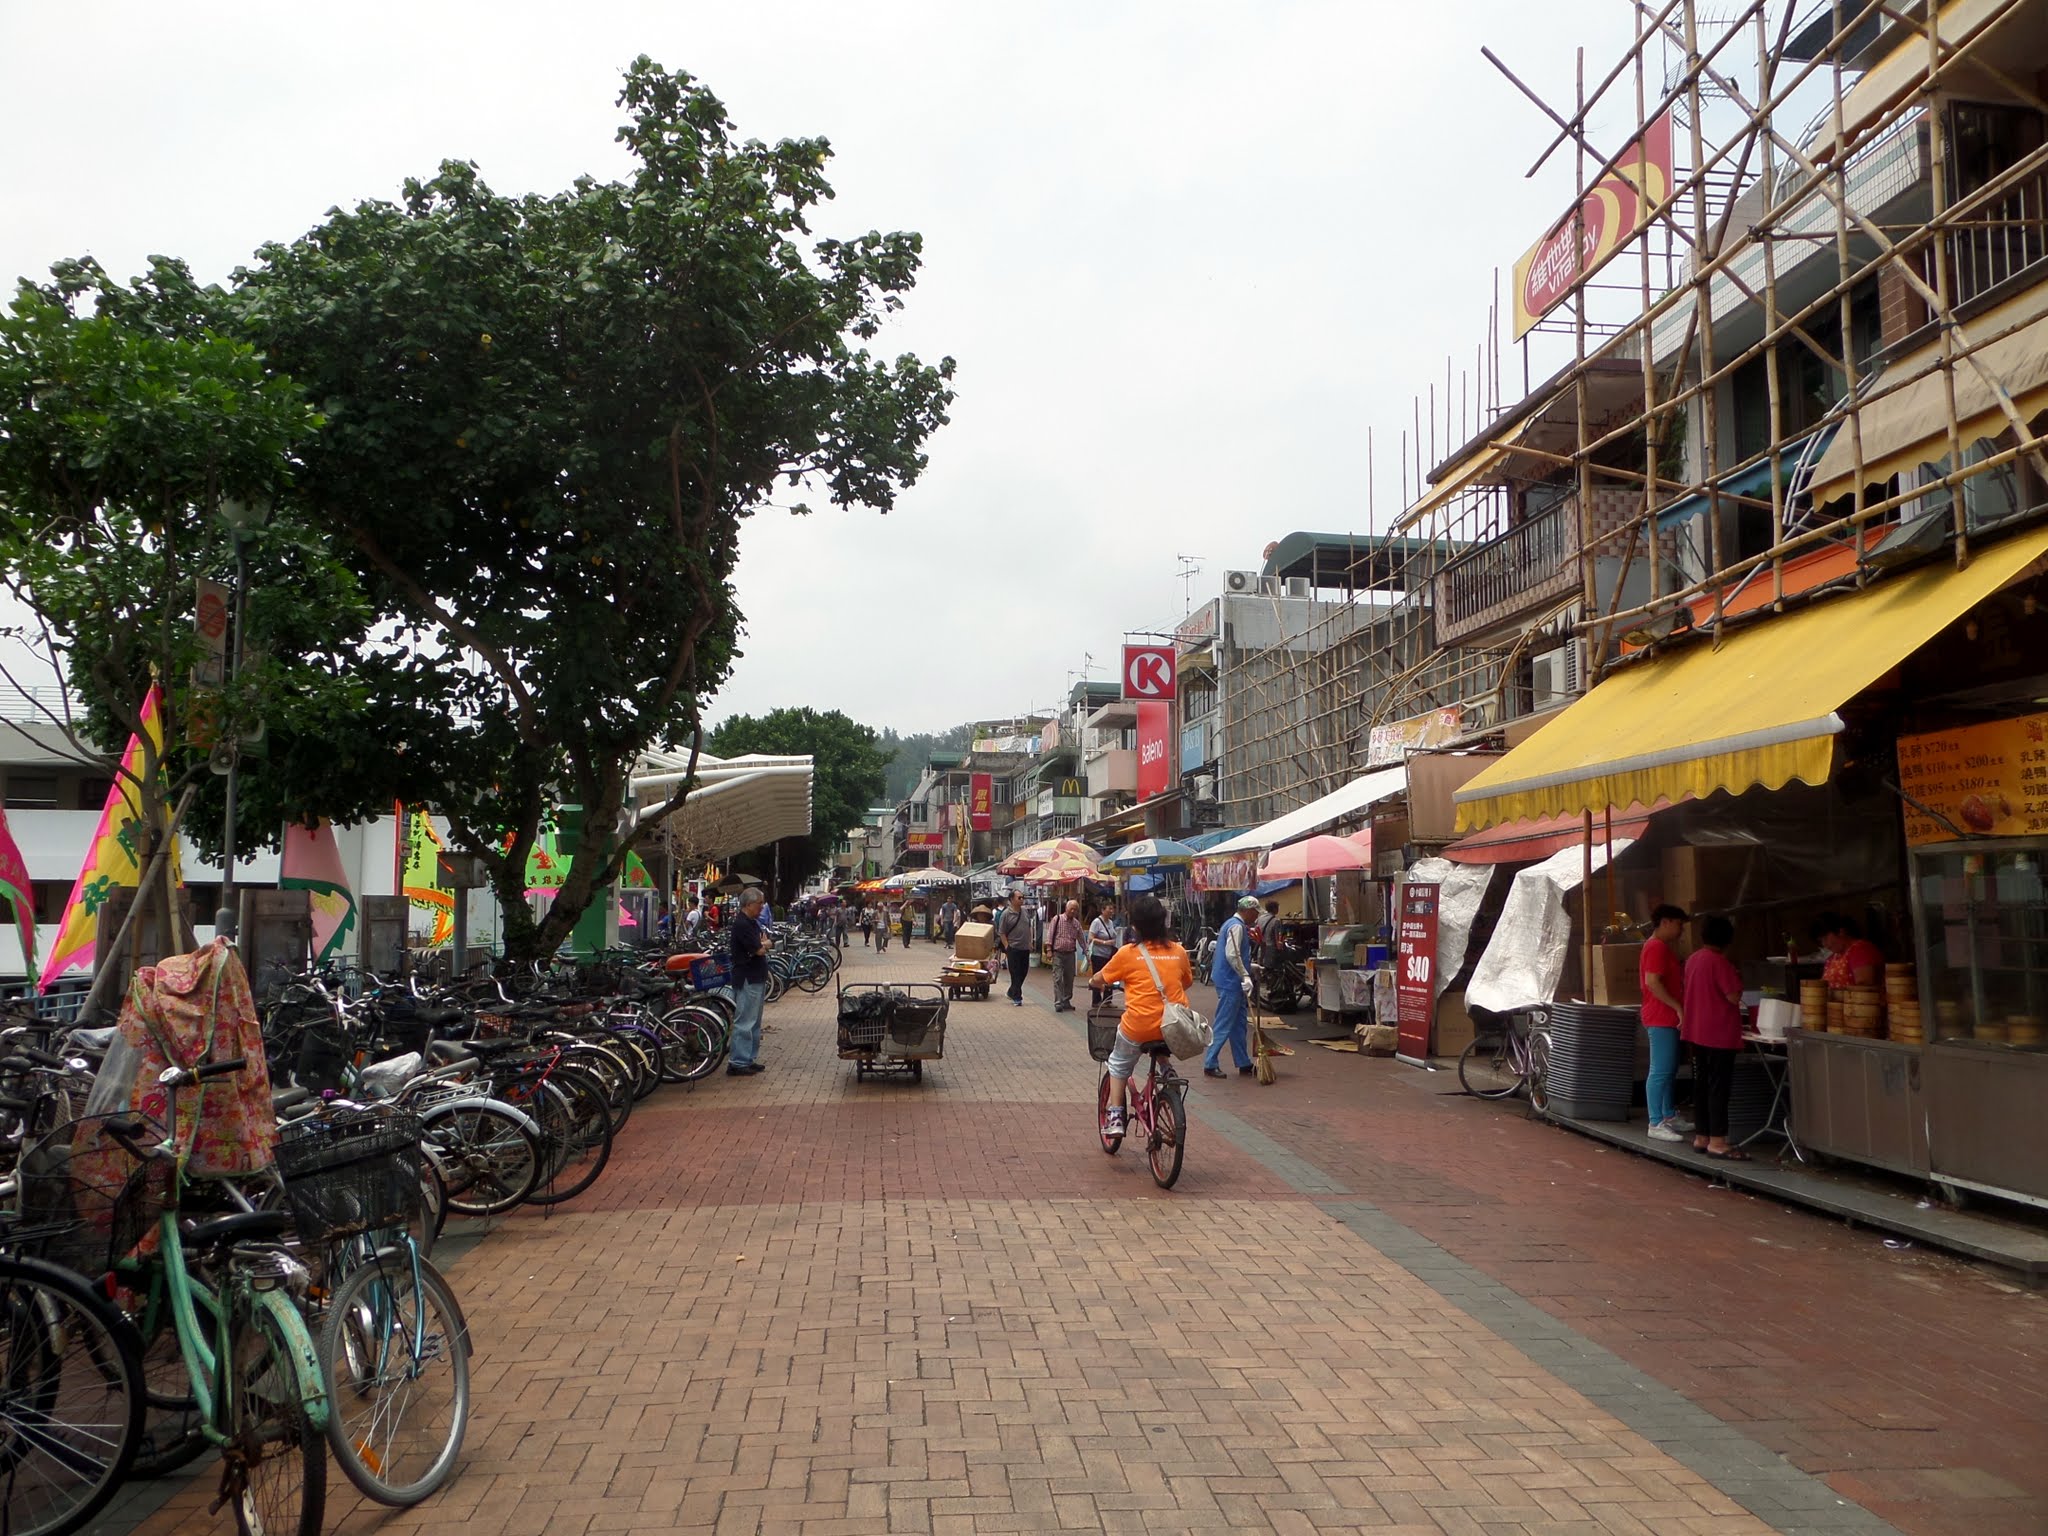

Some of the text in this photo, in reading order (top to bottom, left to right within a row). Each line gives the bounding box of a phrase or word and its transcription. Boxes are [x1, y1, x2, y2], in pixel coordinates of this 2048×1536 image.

[1142, 737, 1163, 765] Baleno
[1959, 776, 1985, 791] $180
[908, 842, 943, 850] wellcome
[1407, 955, 1429, 983] $40
